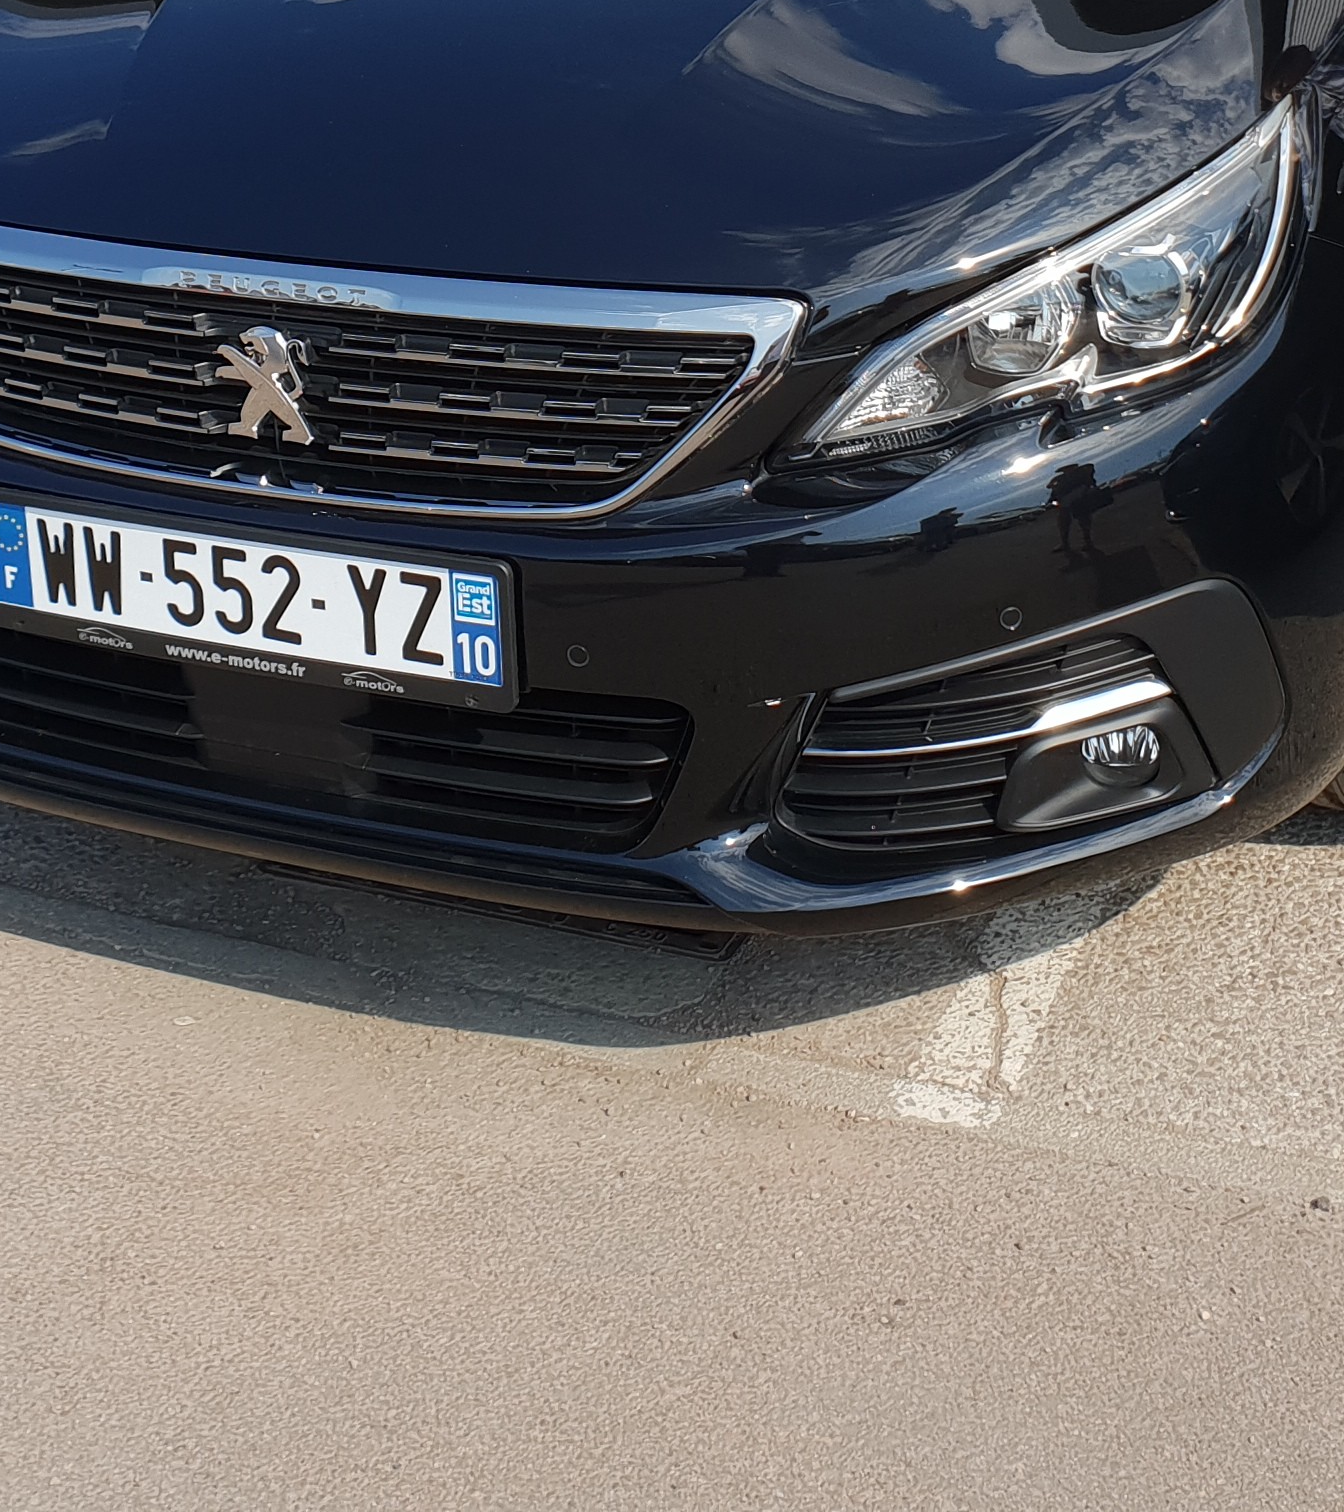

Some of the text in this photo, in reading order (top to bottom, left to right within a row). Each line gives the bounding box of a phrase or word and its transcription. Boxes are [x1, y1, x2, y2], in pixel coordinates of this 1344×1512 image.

[179, 271, 366, 306] PEUGEOT
[4, 565, 19, 589] F
[36, 517, 444, 666] WW-552-YZ
[457, 581, 490, 596] Grand
[458, 593, 491, 615] Est
[165, 642, 306, 678] www.e-motors.fr
[457, 632, 496, 676] 10
